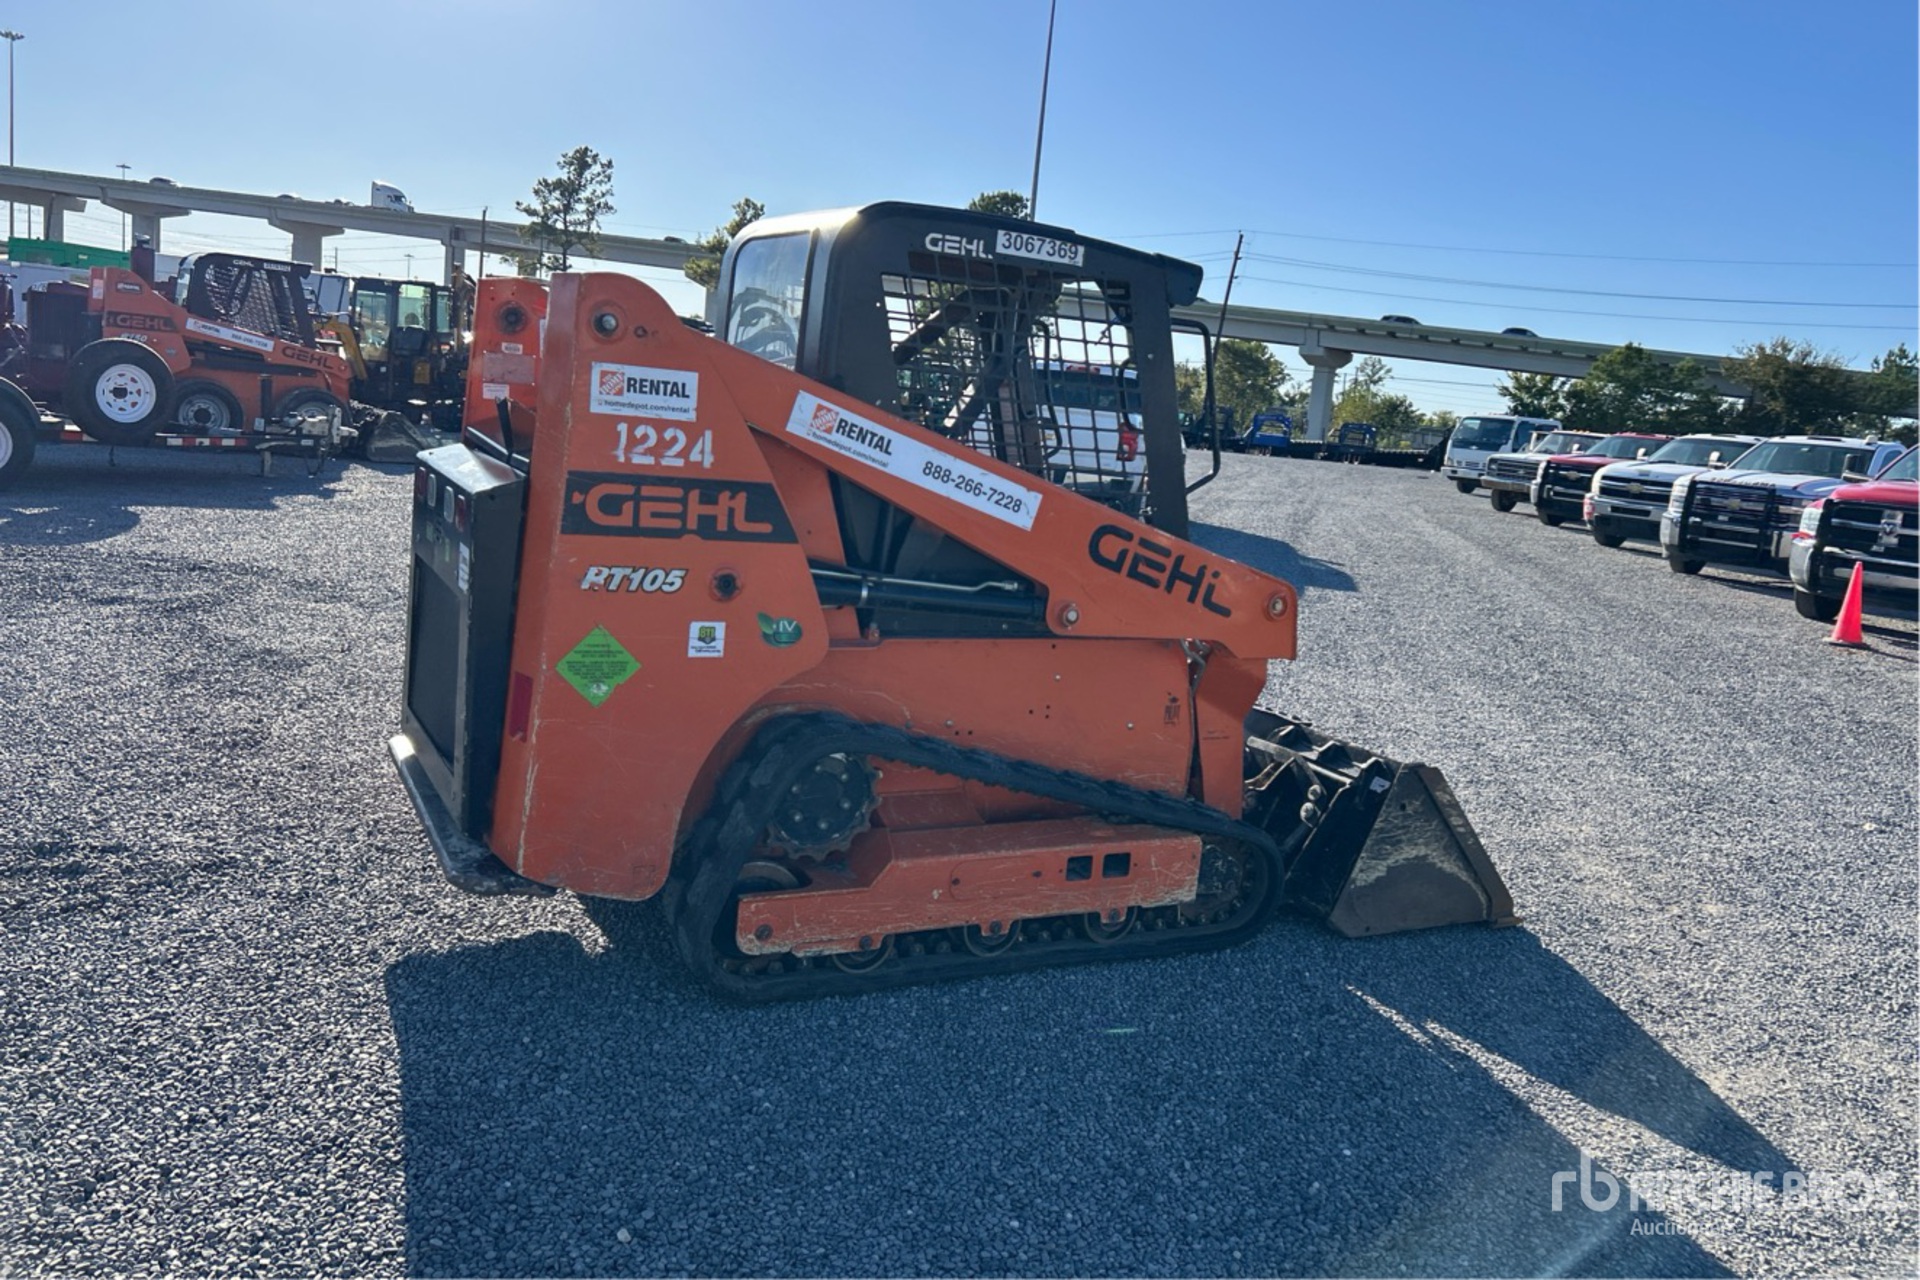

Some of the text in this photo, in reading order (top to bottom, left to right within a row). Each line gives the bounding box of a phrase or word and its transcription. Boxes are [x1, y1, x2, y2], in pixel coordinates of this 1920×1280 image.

[925, 232, 993, 259] GEHL
[1001, 231, 1079, 261] 3067369
[116, 314, 176, 330] GEHL
[281, 346, 333, 369] GEHL
[626, 377, 690, 398] RENTAL
[604, 400, 690, 413] homedepot.com/rental
[615, 422, 714, 468] 1224
[812, 431, 889, 468] homedepot.com/rental
[836, 418, 892, 456] RENTAL
[922, 461, 1022, 513] 888-266-7228
[585, 482, 773, 533] GEHL
[580, 565, 688, 592] RT105
[1088, 524, 1232, 618] GEHL
